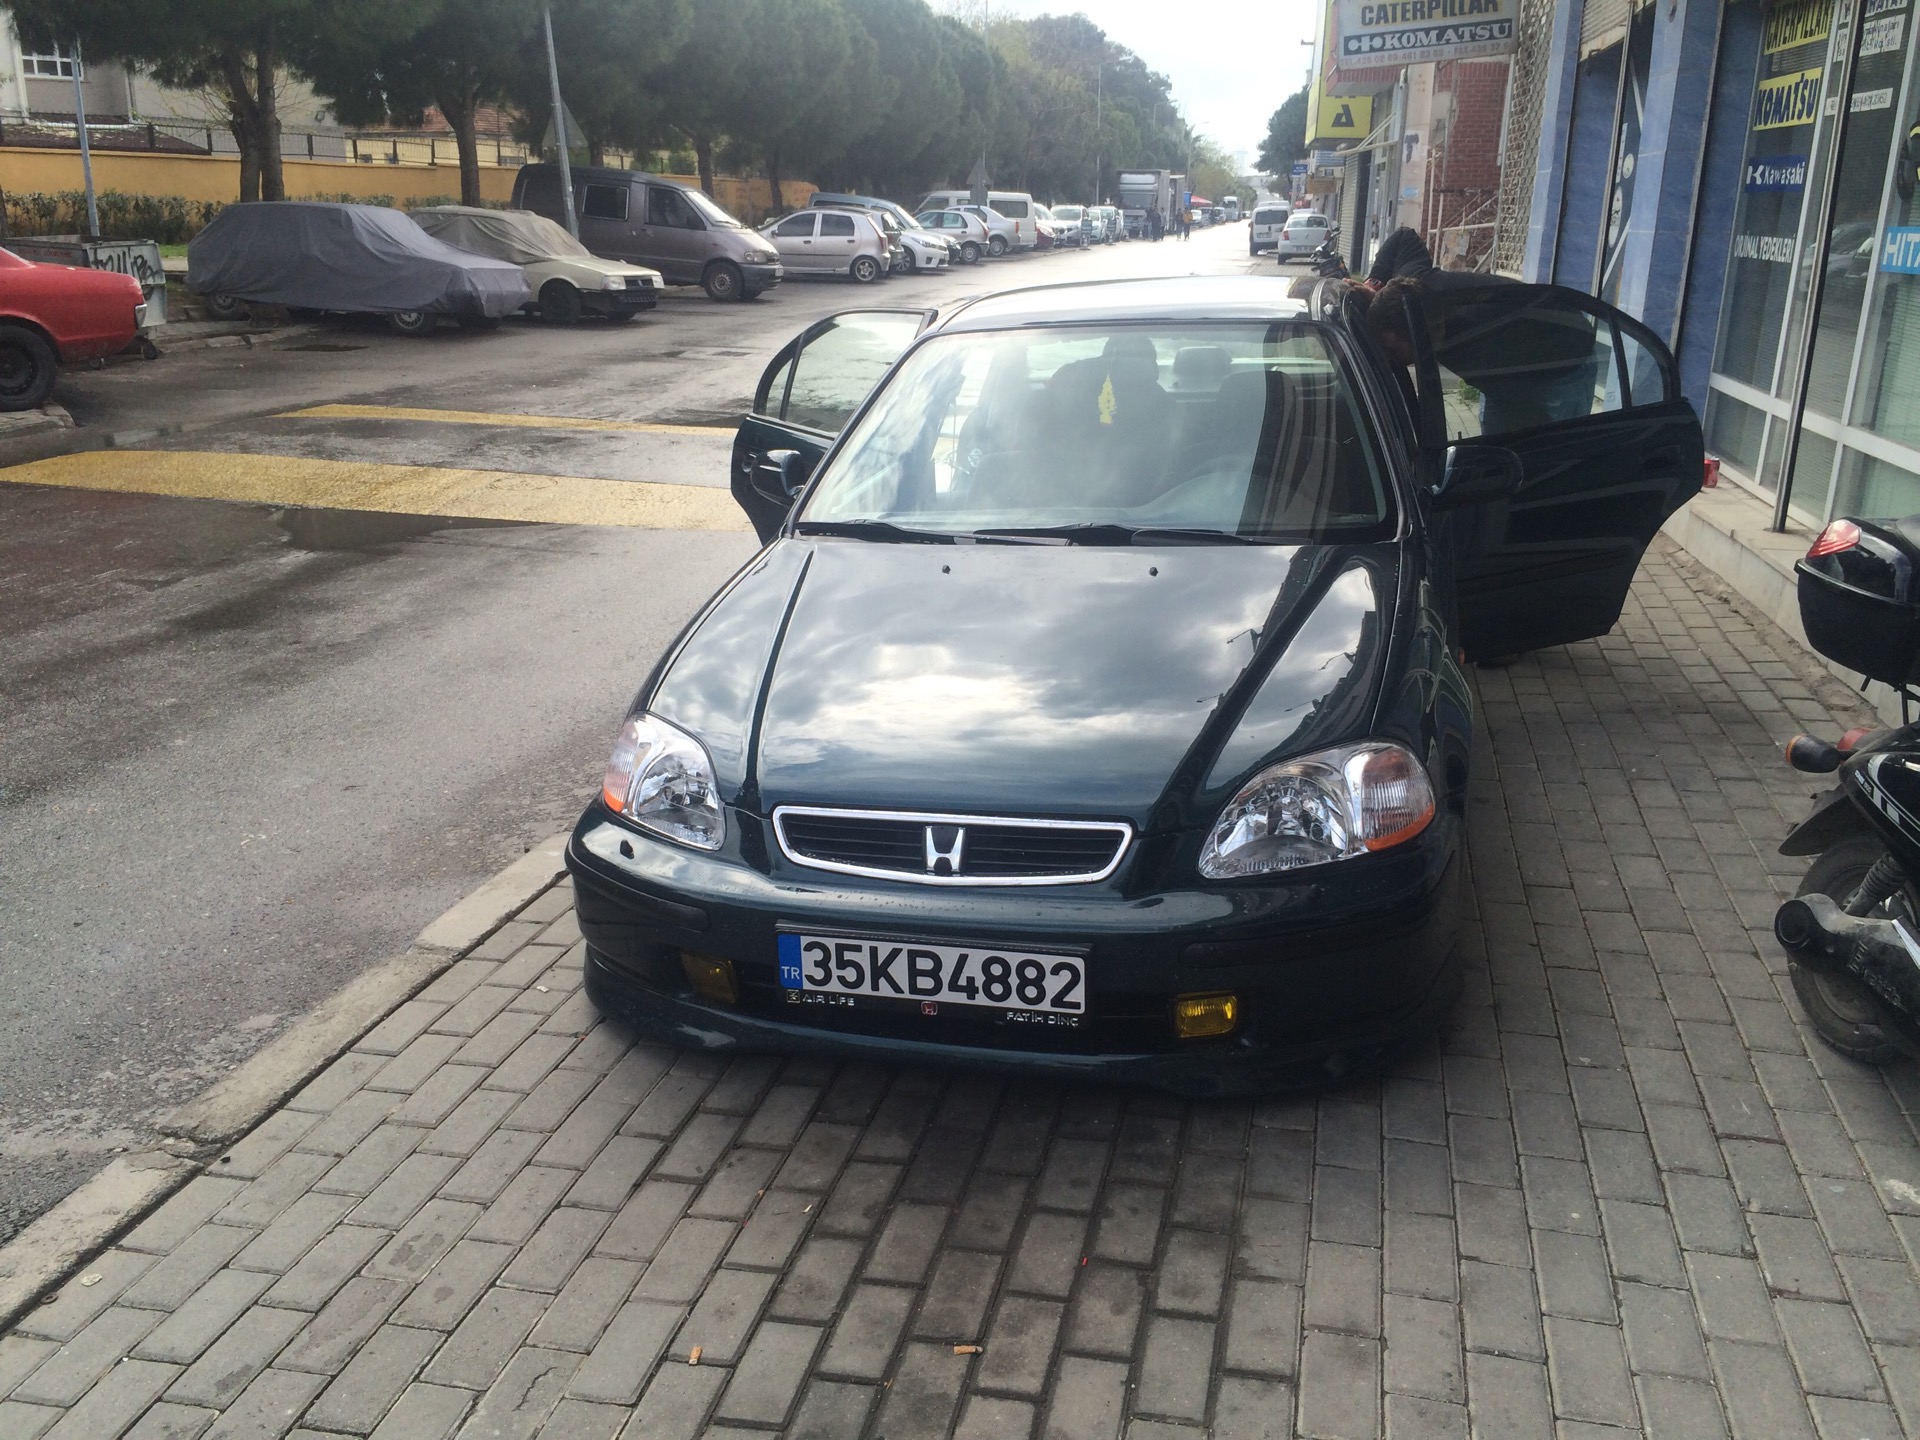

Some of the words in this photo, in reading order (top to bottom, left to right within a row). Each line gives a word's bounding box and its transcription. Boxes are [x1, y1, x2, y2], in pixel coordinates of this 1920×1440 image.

[1361, 0, 1499, 27] CATERPILLAR
[1384, 22, 1511, 50] KOMATSU
[1754, 73, 1820, 127] KOMATSU
[1763, 162, 1806, 185] Kawasaki
[781, 966, 801, 980] TR
[803, 941, 1082, 1011] 35KB4882
[1006, 1011, 1044, 1024] FATİH
[1047, 1014, 1080, 1028] DİNÇ
